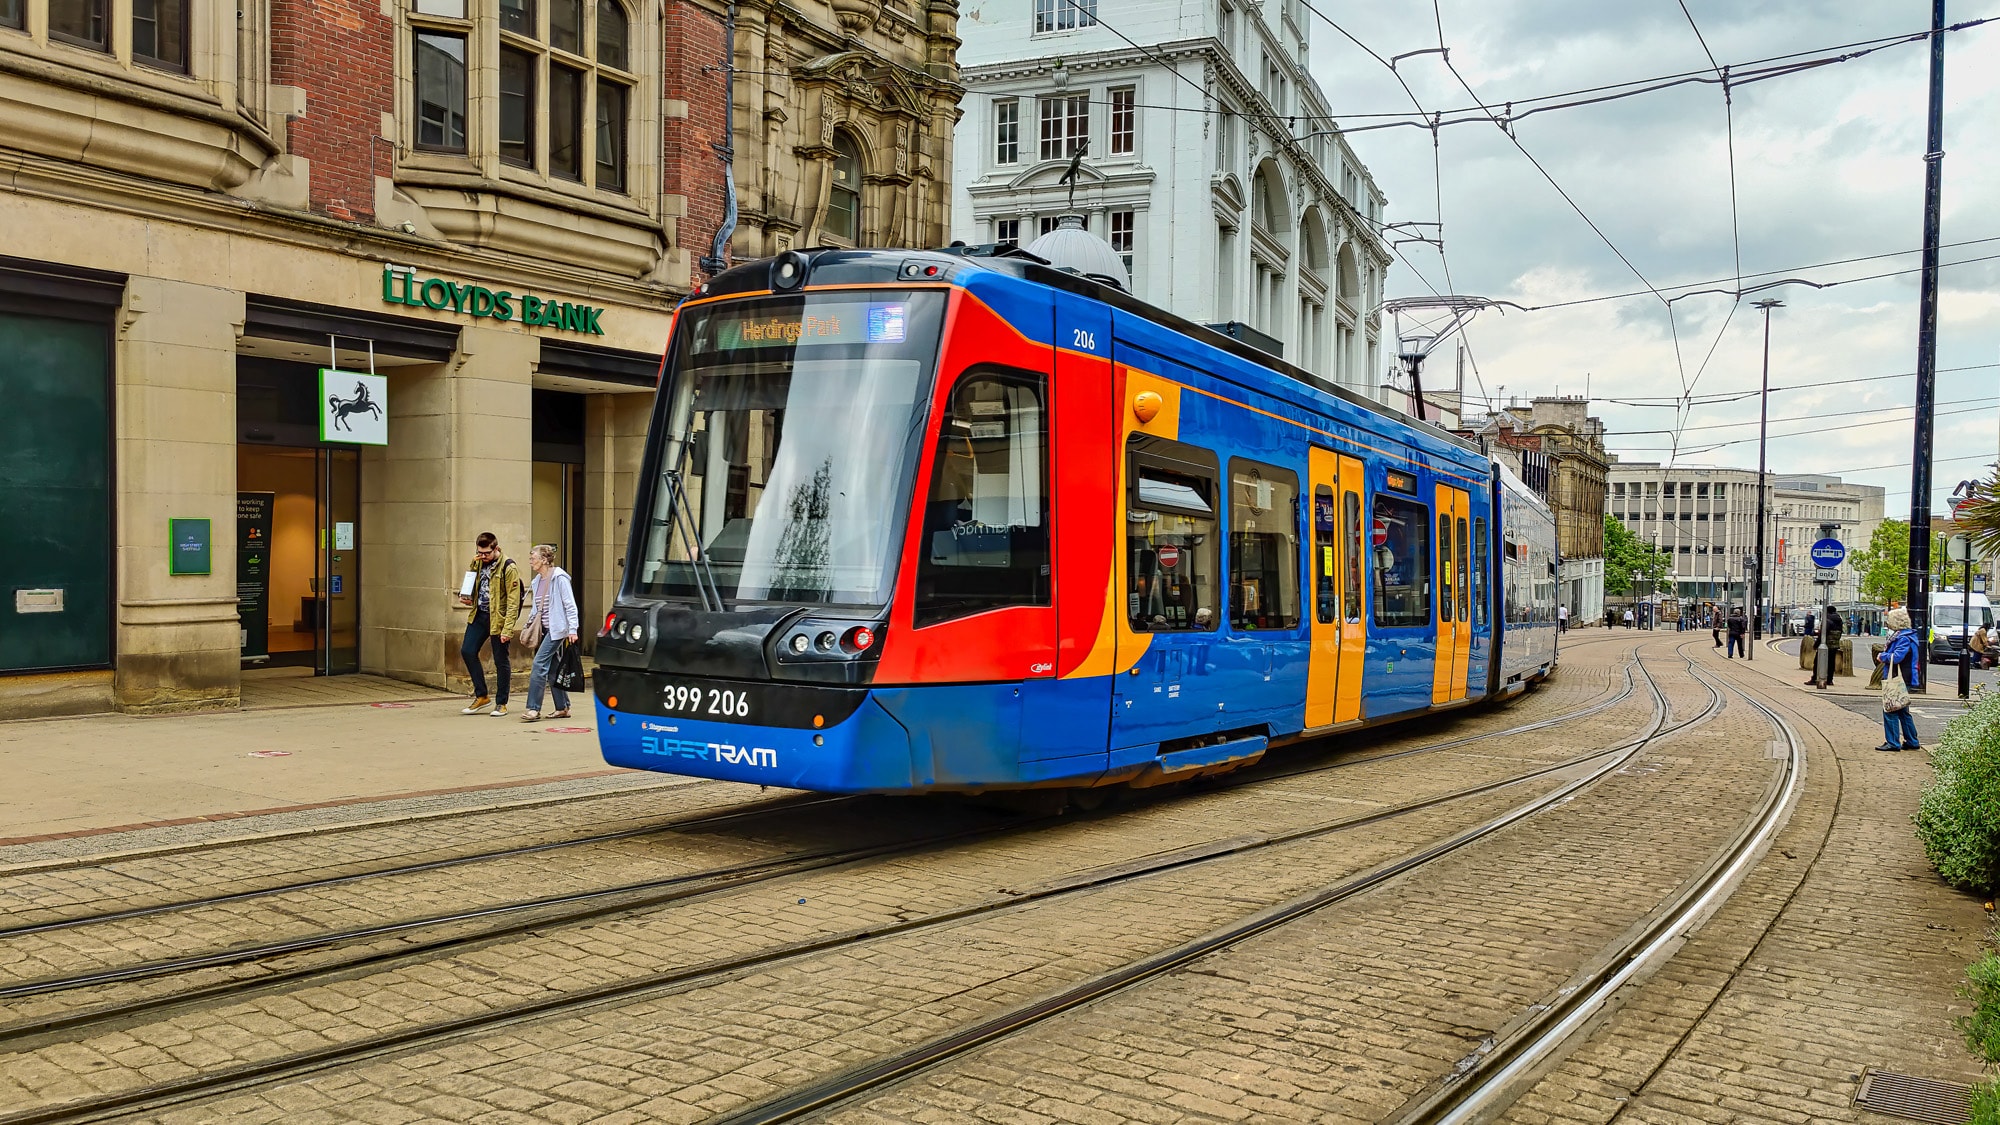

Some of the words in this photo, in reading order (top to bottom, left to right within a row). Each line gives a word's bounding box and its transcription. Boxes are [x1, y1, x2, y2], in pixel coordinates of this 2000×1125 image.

[383, 269, 513, 321] LLOYDS
[522, 295, 604, 335] BANK
[742, 318, 802, 342] Herdings
[807, 315, 841, 337] Park
[1073, 328, 1095, 350] 206
[663, 685, 702, 712] 399
[707, 689, 749, 717] 206
[641, 736, 777, 768] SUPERTRAM
